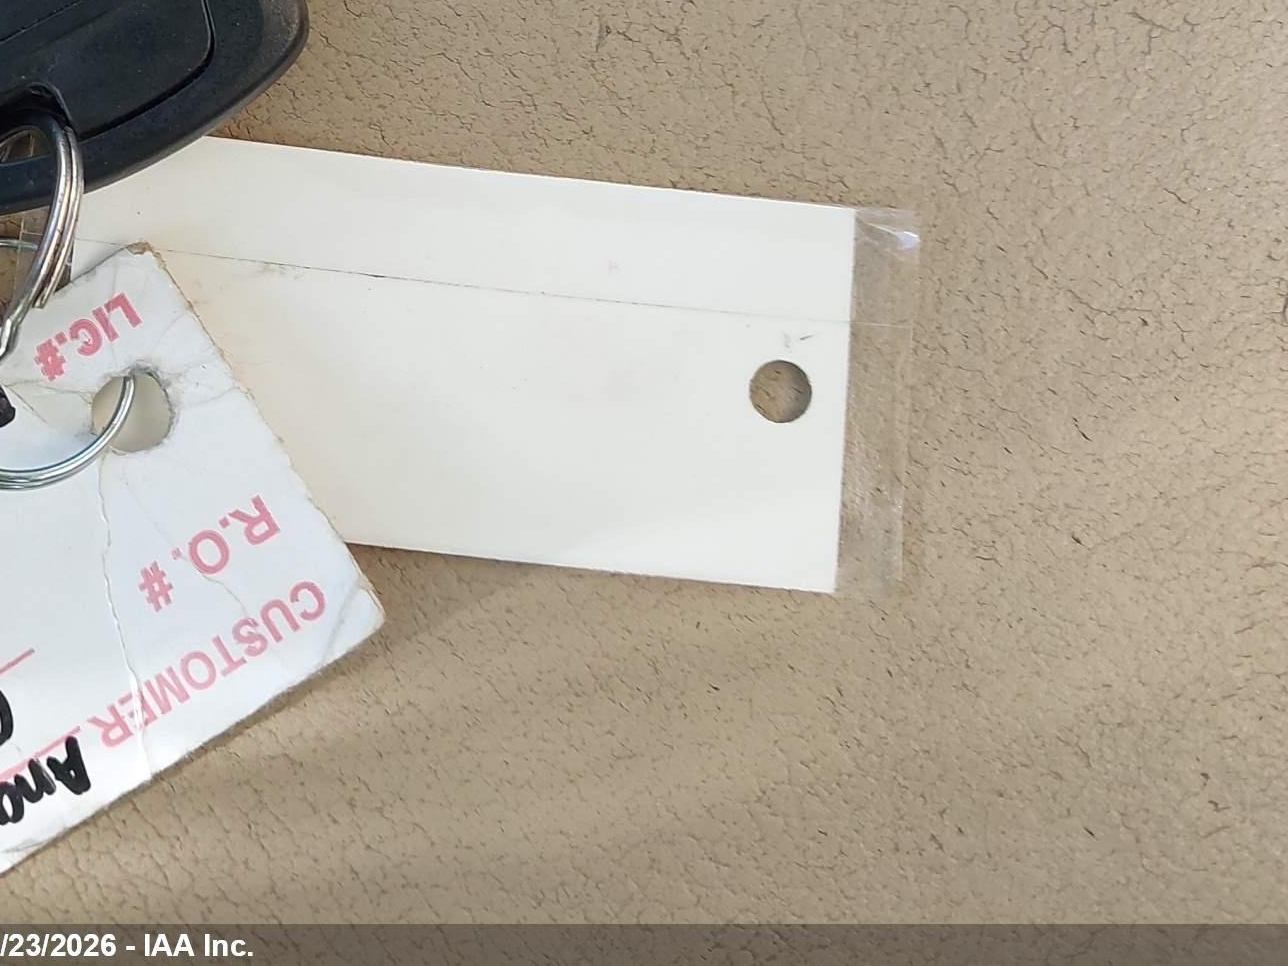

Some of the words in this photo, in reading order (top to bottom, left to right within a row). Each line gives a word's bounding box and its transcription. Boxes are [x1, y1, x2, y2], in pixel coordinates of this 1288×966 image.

[33, 291, 143, 382] LIC.#
[171, 494, 281, 575] R.O.
[138, 560, 174, 613] #
[86, 580, 326, 748] CUSTOMER
